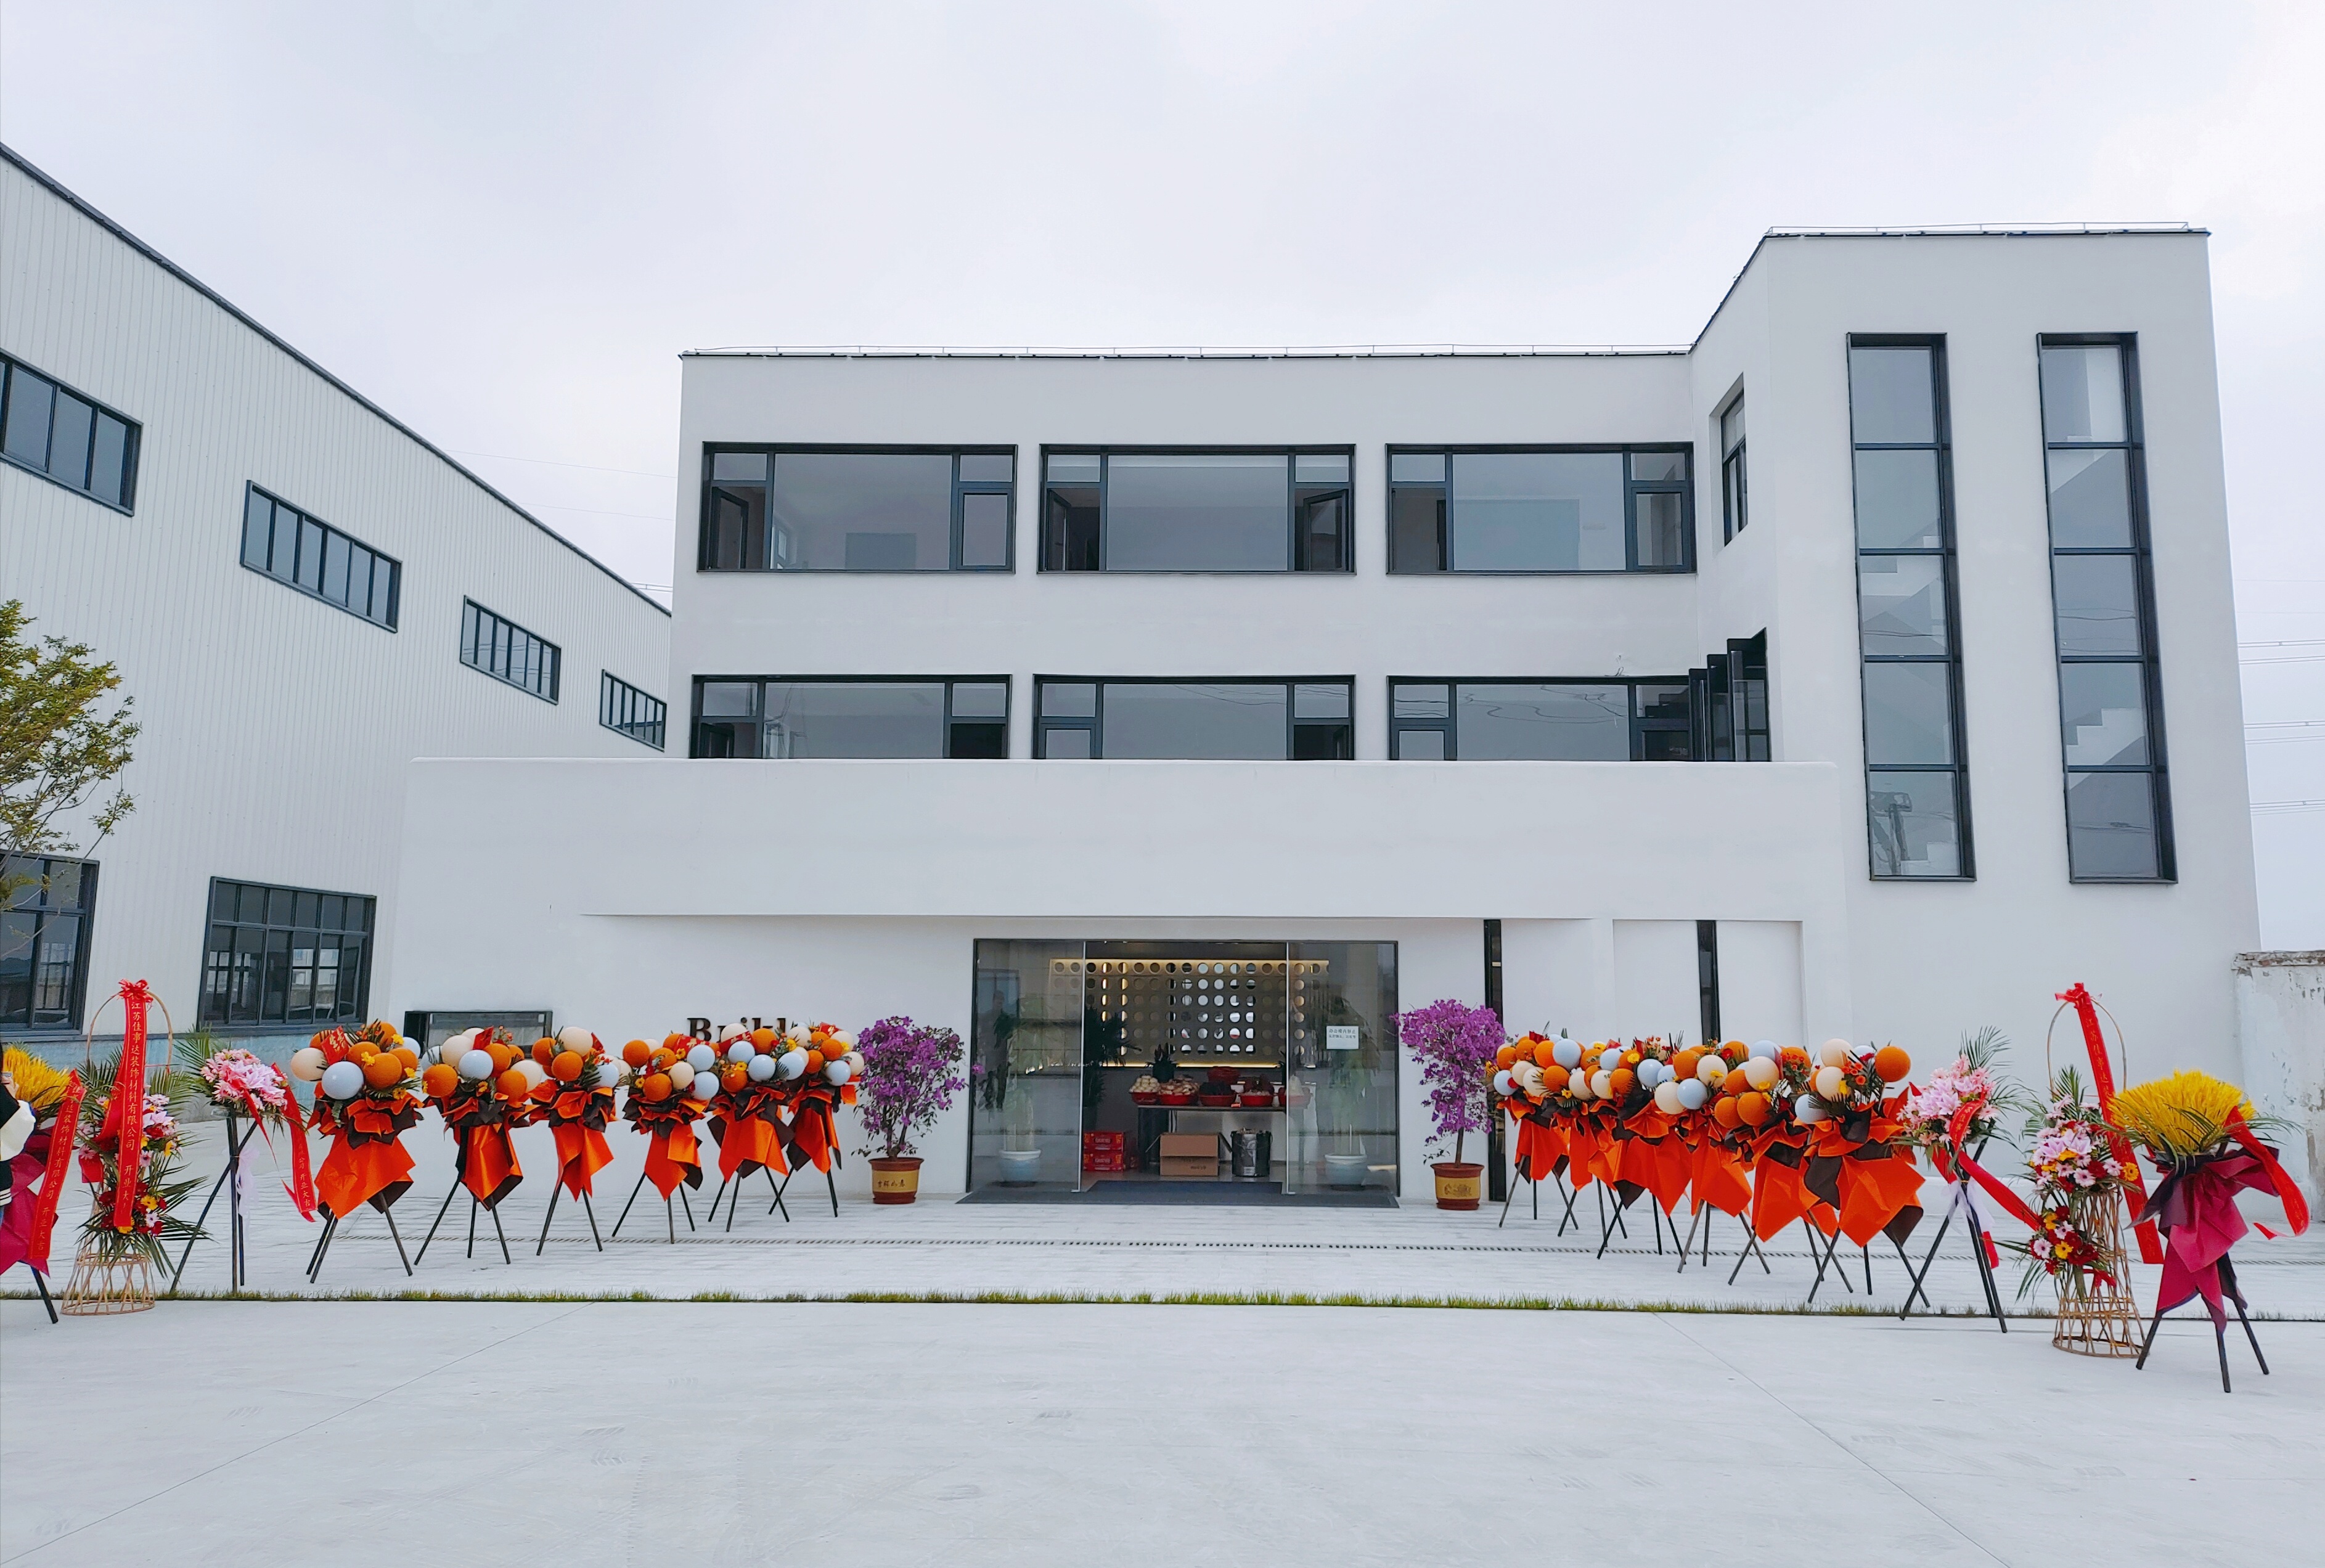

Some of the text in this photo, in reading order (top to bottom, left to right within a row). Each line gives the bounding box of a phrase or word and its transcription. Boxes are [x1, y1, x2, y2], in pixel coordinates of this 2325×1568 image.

[123, 1164, 134, 1211] 开业大
[299, 1172, 311, 1207] 开业大吉
[38, 1206, 50, 1251] 开业大吉
